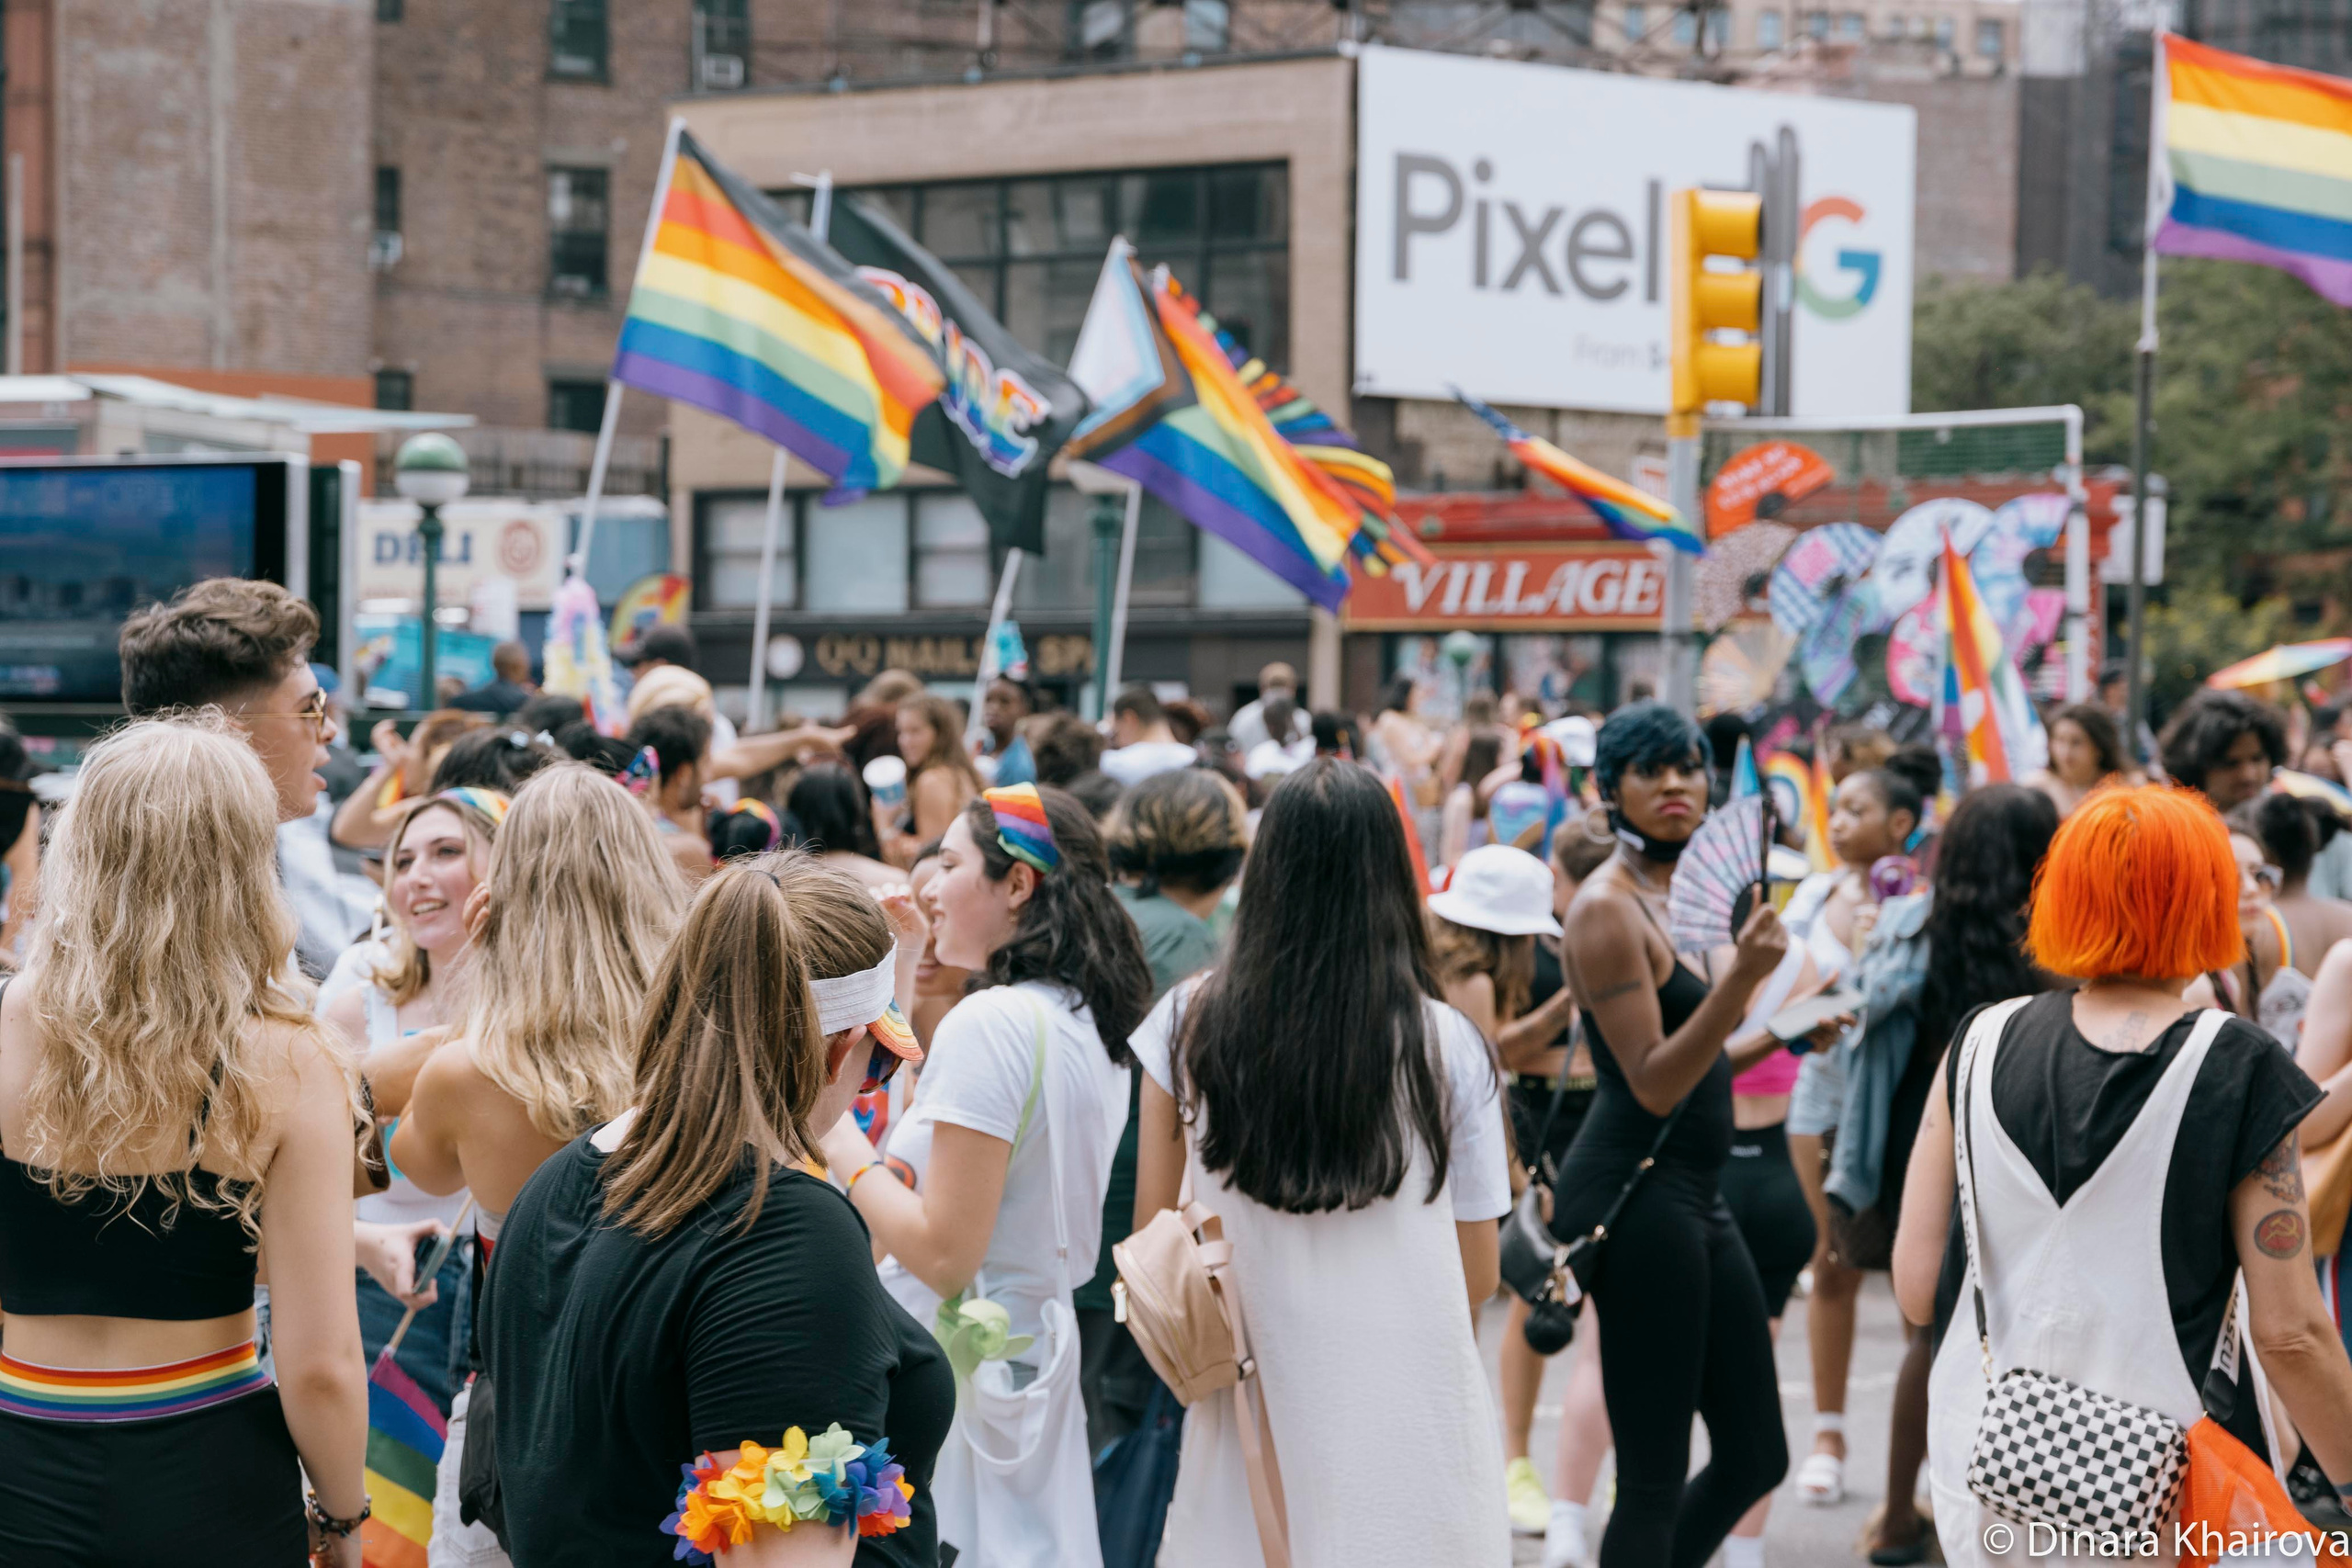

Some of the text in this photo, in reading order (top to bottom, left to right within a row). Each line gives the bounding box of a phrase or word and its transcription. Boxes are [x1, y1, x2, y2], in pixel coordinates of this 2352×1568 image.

[1392, 151, 1661, 304] Pixel
[1794, 196, 1882, 321] G
[1391, 558, 1667, 615] VILLAGE
